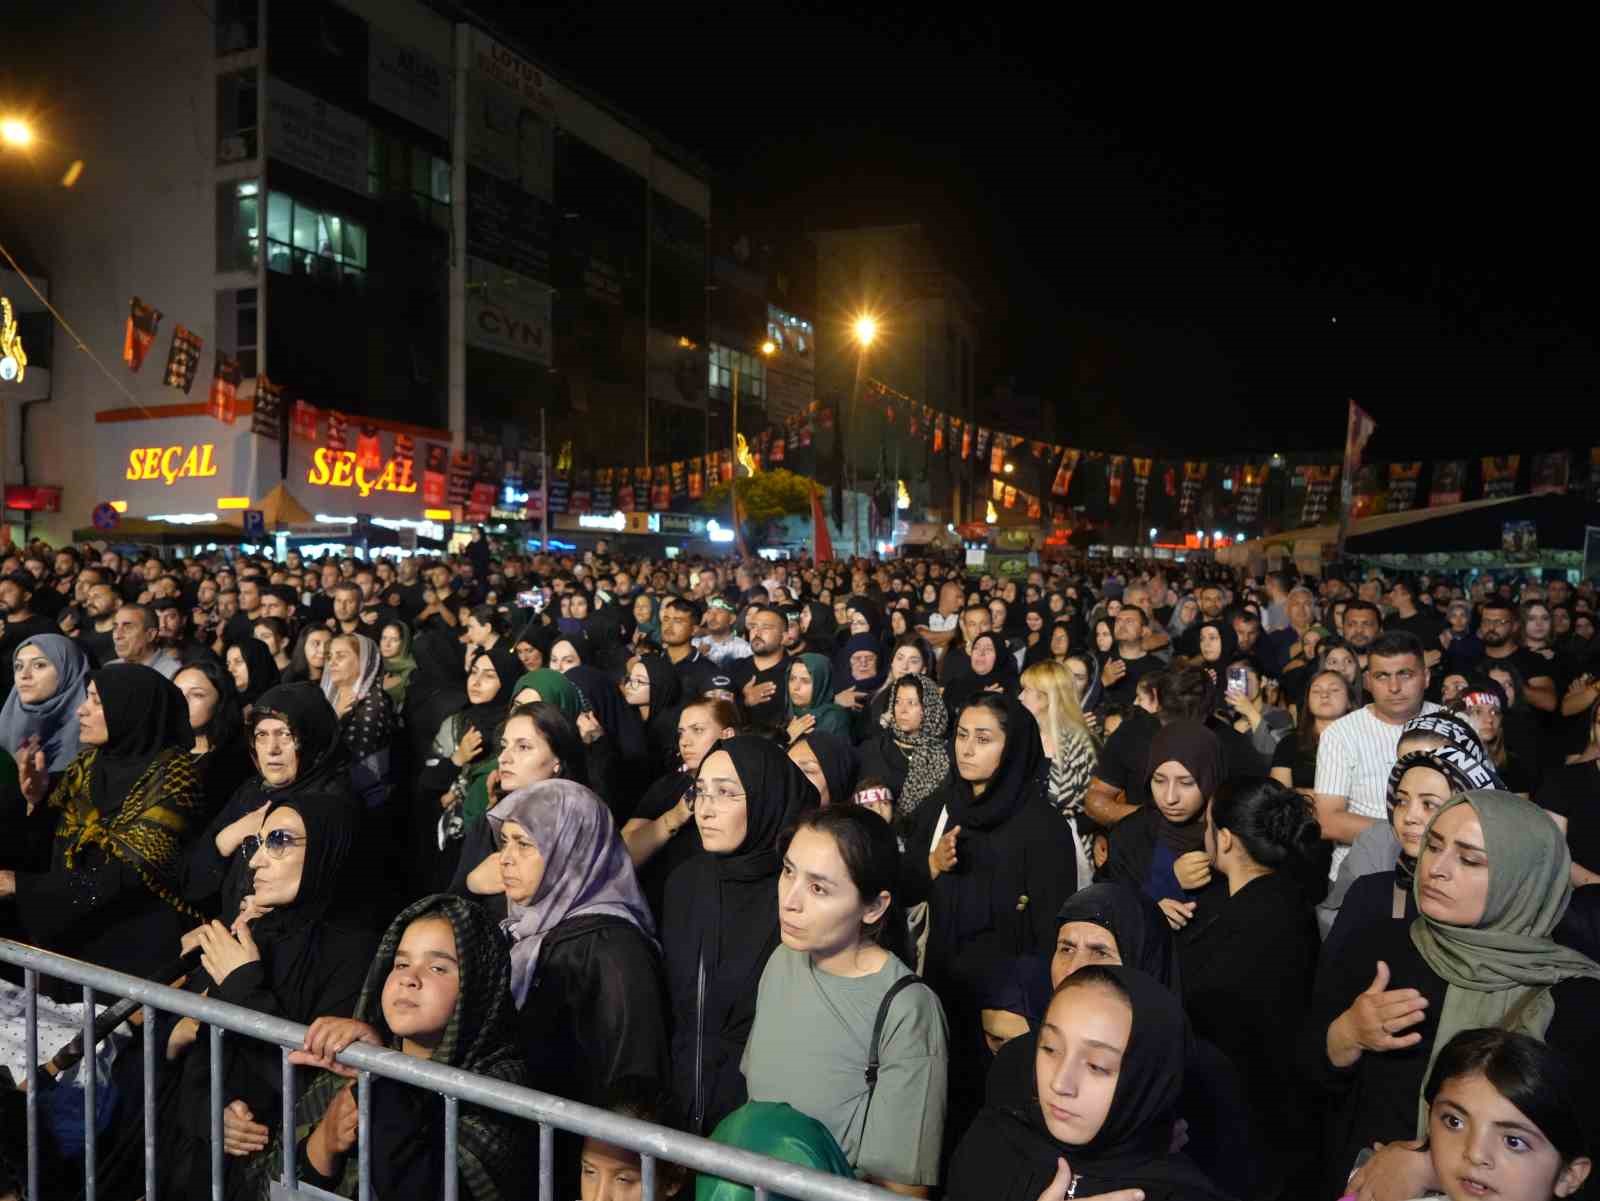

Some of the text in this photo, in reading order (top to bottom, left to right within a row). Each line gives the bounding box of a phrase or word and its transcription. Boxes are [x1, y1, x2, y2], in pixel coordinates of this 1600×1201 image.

[491, 44, 544, 87] LOTUS
[478, 309, 543, 348] CYN
[126, 444, 217, 485] SEÇAL
[308, 447, 418, 497] SEÇAL
